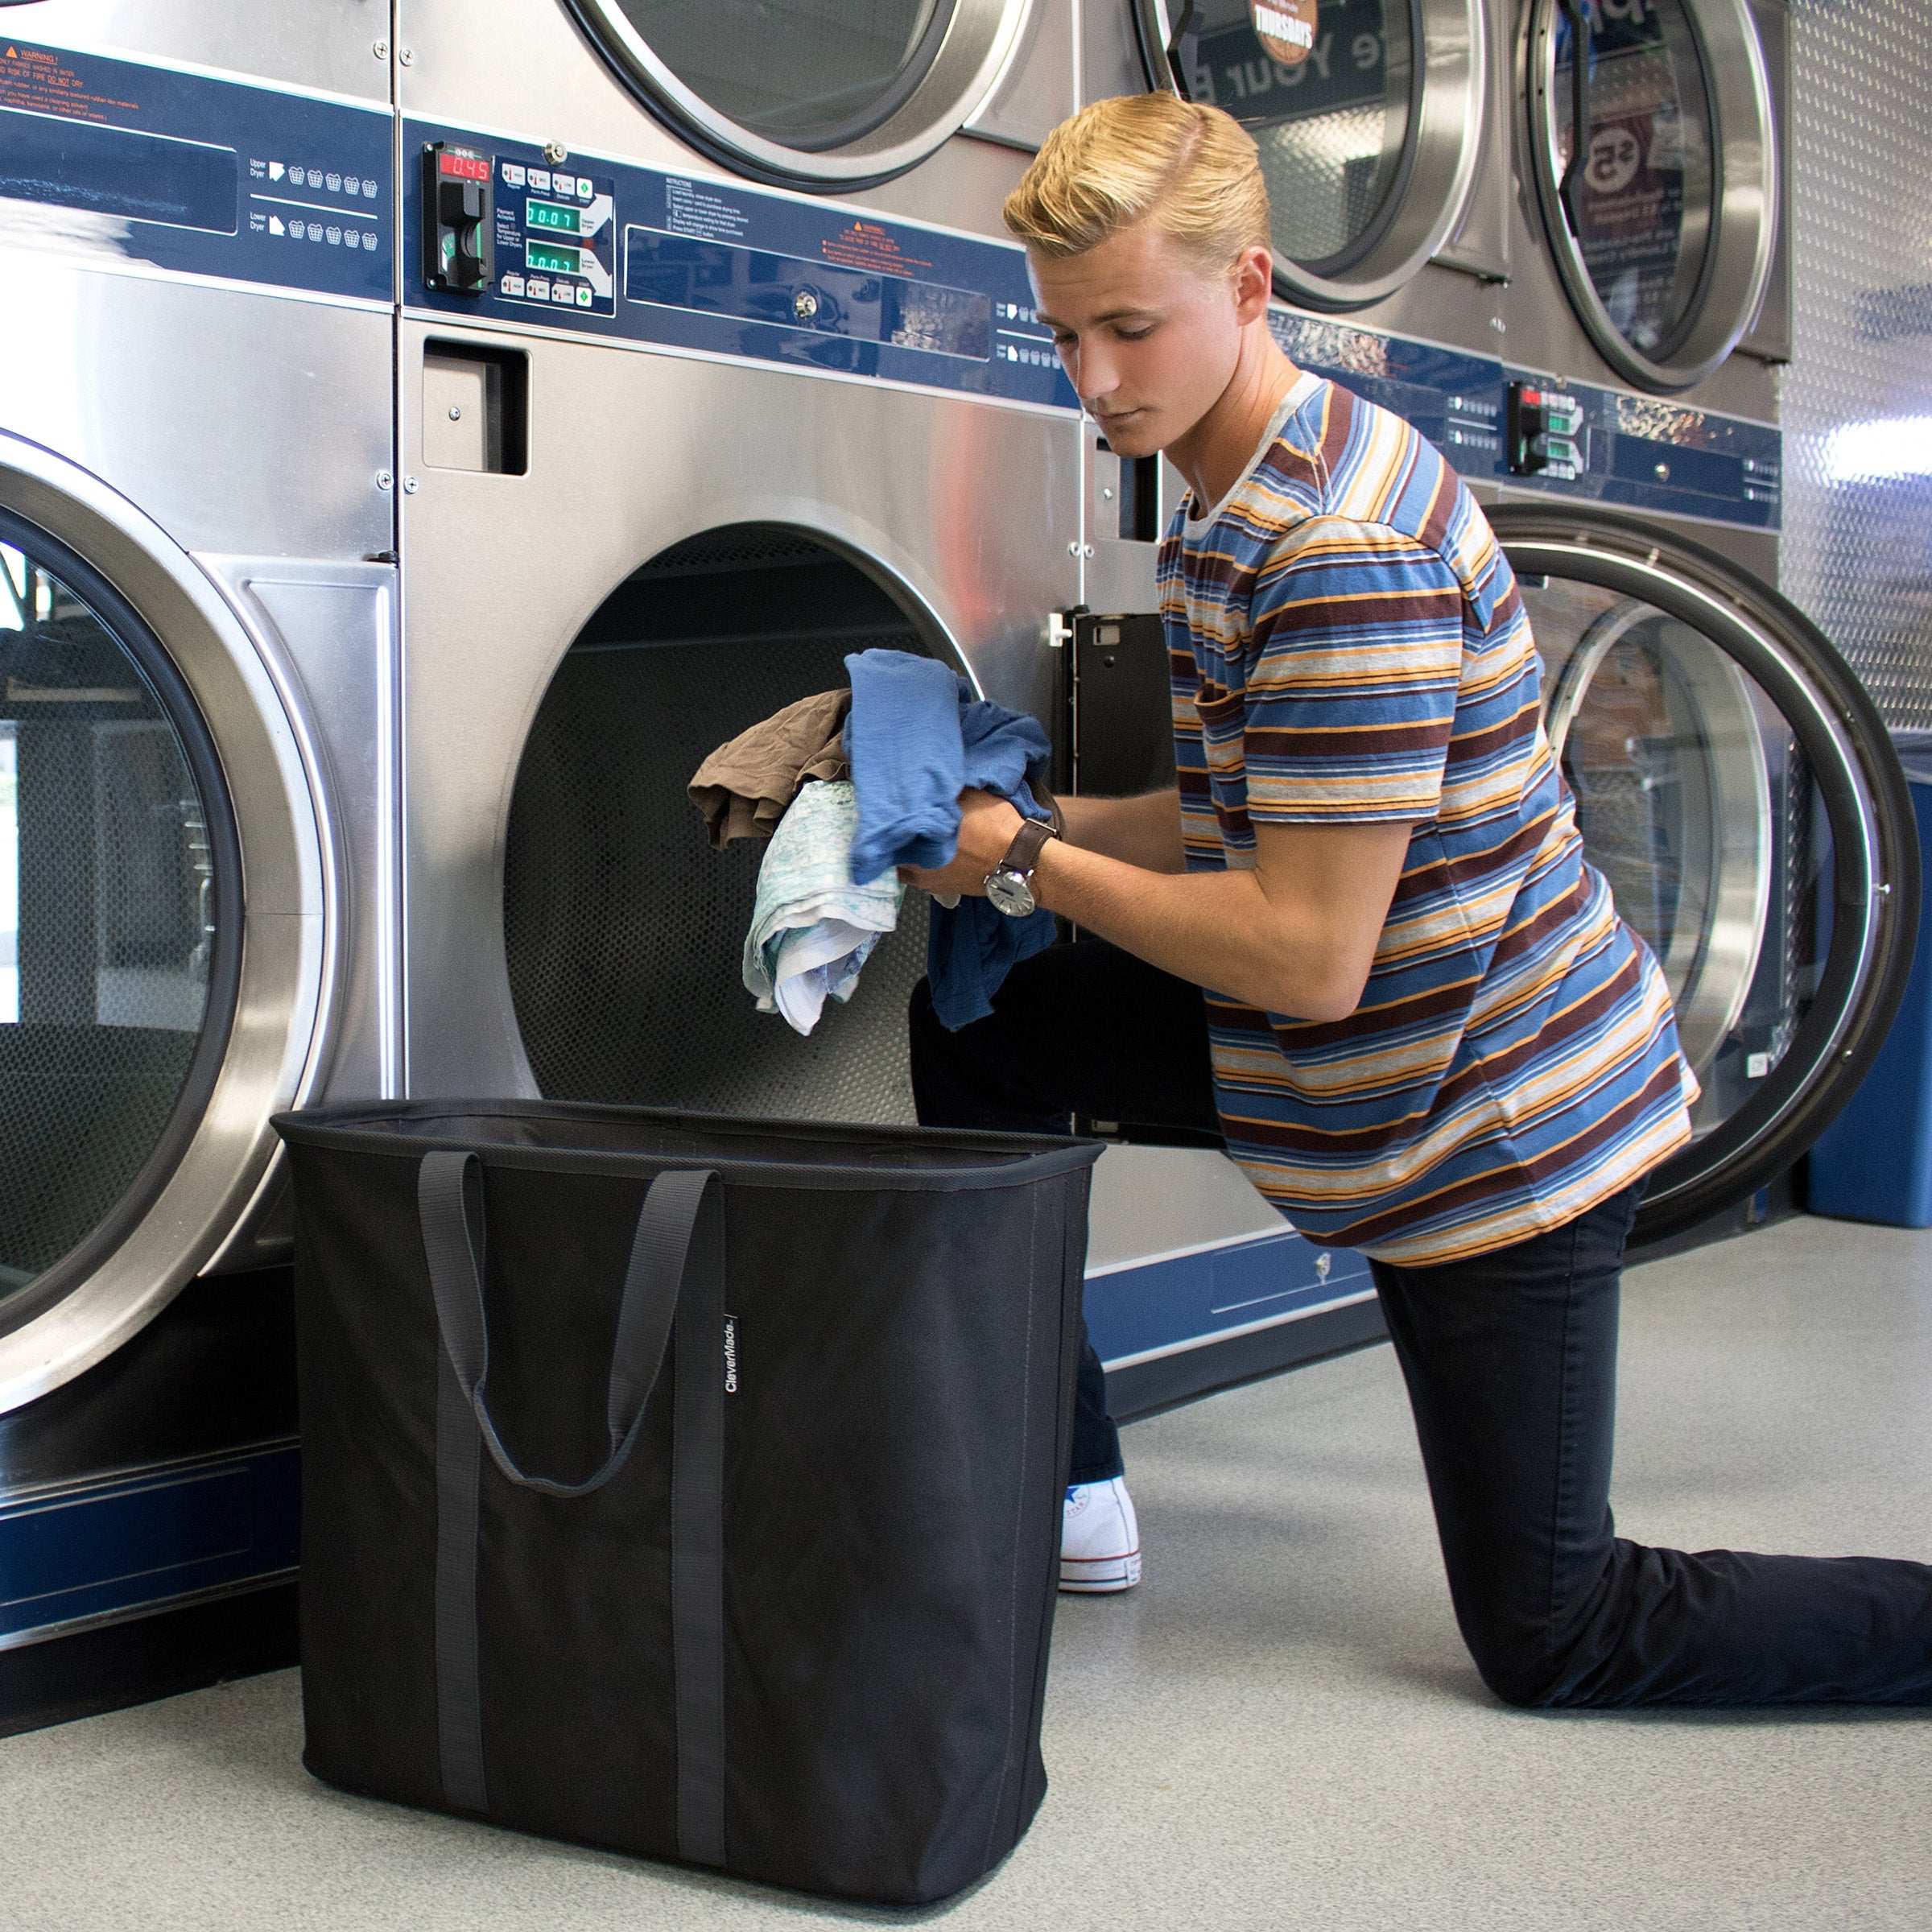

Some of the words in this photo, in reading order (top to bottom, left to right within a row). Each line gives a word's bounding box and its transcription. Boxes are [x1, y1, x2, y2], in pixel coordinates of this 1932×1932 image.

[250, 158, 266, 169] Upper
[452, 156, 489, 180] 0.45
[250, 167, 265, 179] Dryer
[250, 211, 266, 221] Lower
[250, 221, 265, 232] Dryer
[724, 1323, 737, 1393] CleverMade
